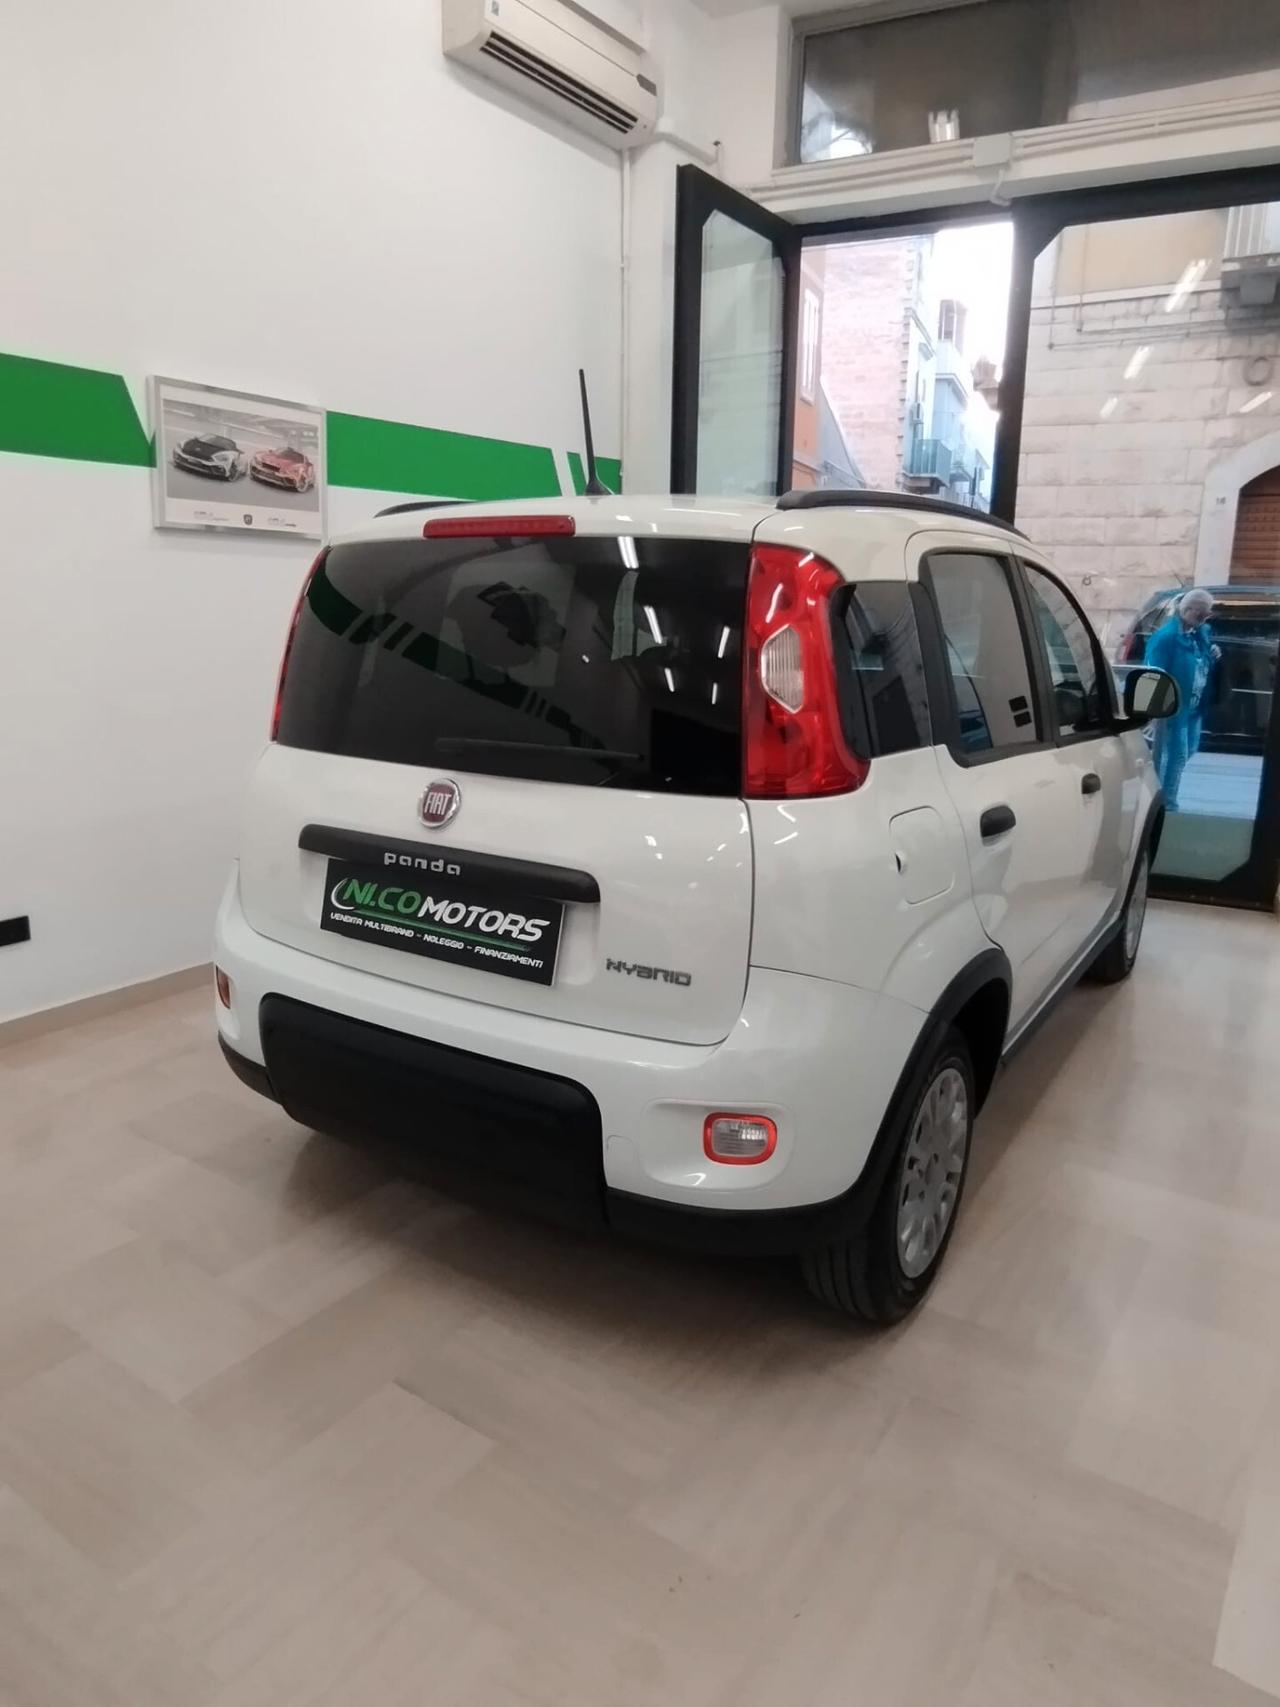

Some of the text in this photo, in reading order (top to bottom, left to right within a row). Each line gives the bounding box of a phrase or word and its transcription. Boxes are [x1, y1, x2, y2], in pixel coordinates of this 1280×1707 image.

[424, 791, 452, 815] FIAT
[383, 851, 461, 876] panda
[330, 911, 363, 926] VENDITA
[364, 919, 415, 938] MULTIBRAND
[422, 933, 465, 950] NOLEGGIO
[474, 945, 544, 969] FINANZIAMENTI
[605, 957, 692, 987] HYBRID
